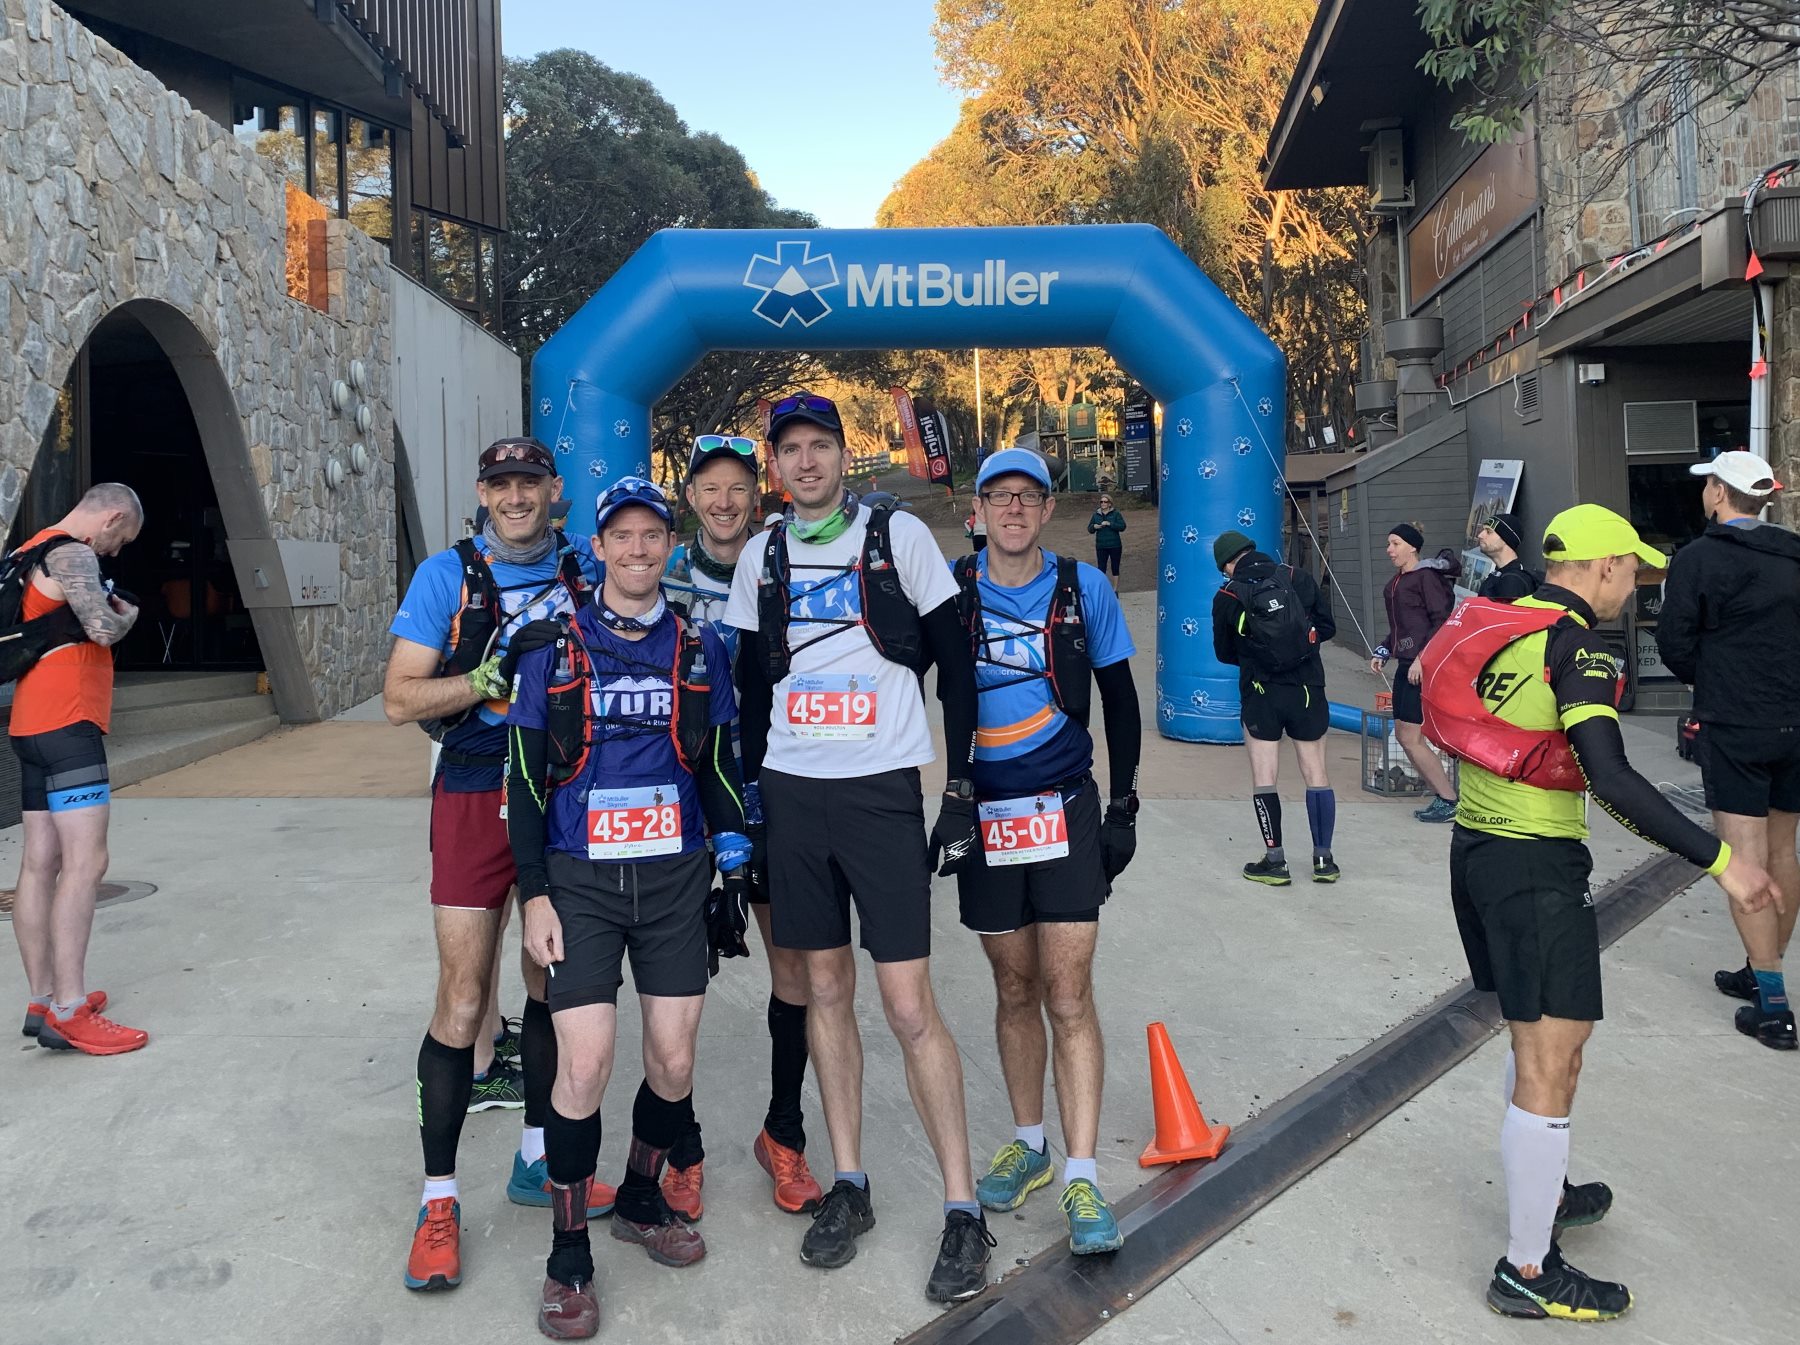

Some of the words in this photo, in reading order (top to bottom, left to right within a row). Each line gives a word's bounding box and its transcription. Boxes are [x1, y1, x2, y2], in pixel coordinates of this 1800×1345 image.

[919, 415, 939, 458] injinji
[791, 694, 871, 724] 45-19
[593, 806, 677, 841] 45-28
[987, 813, 1060, 849] 45-07
